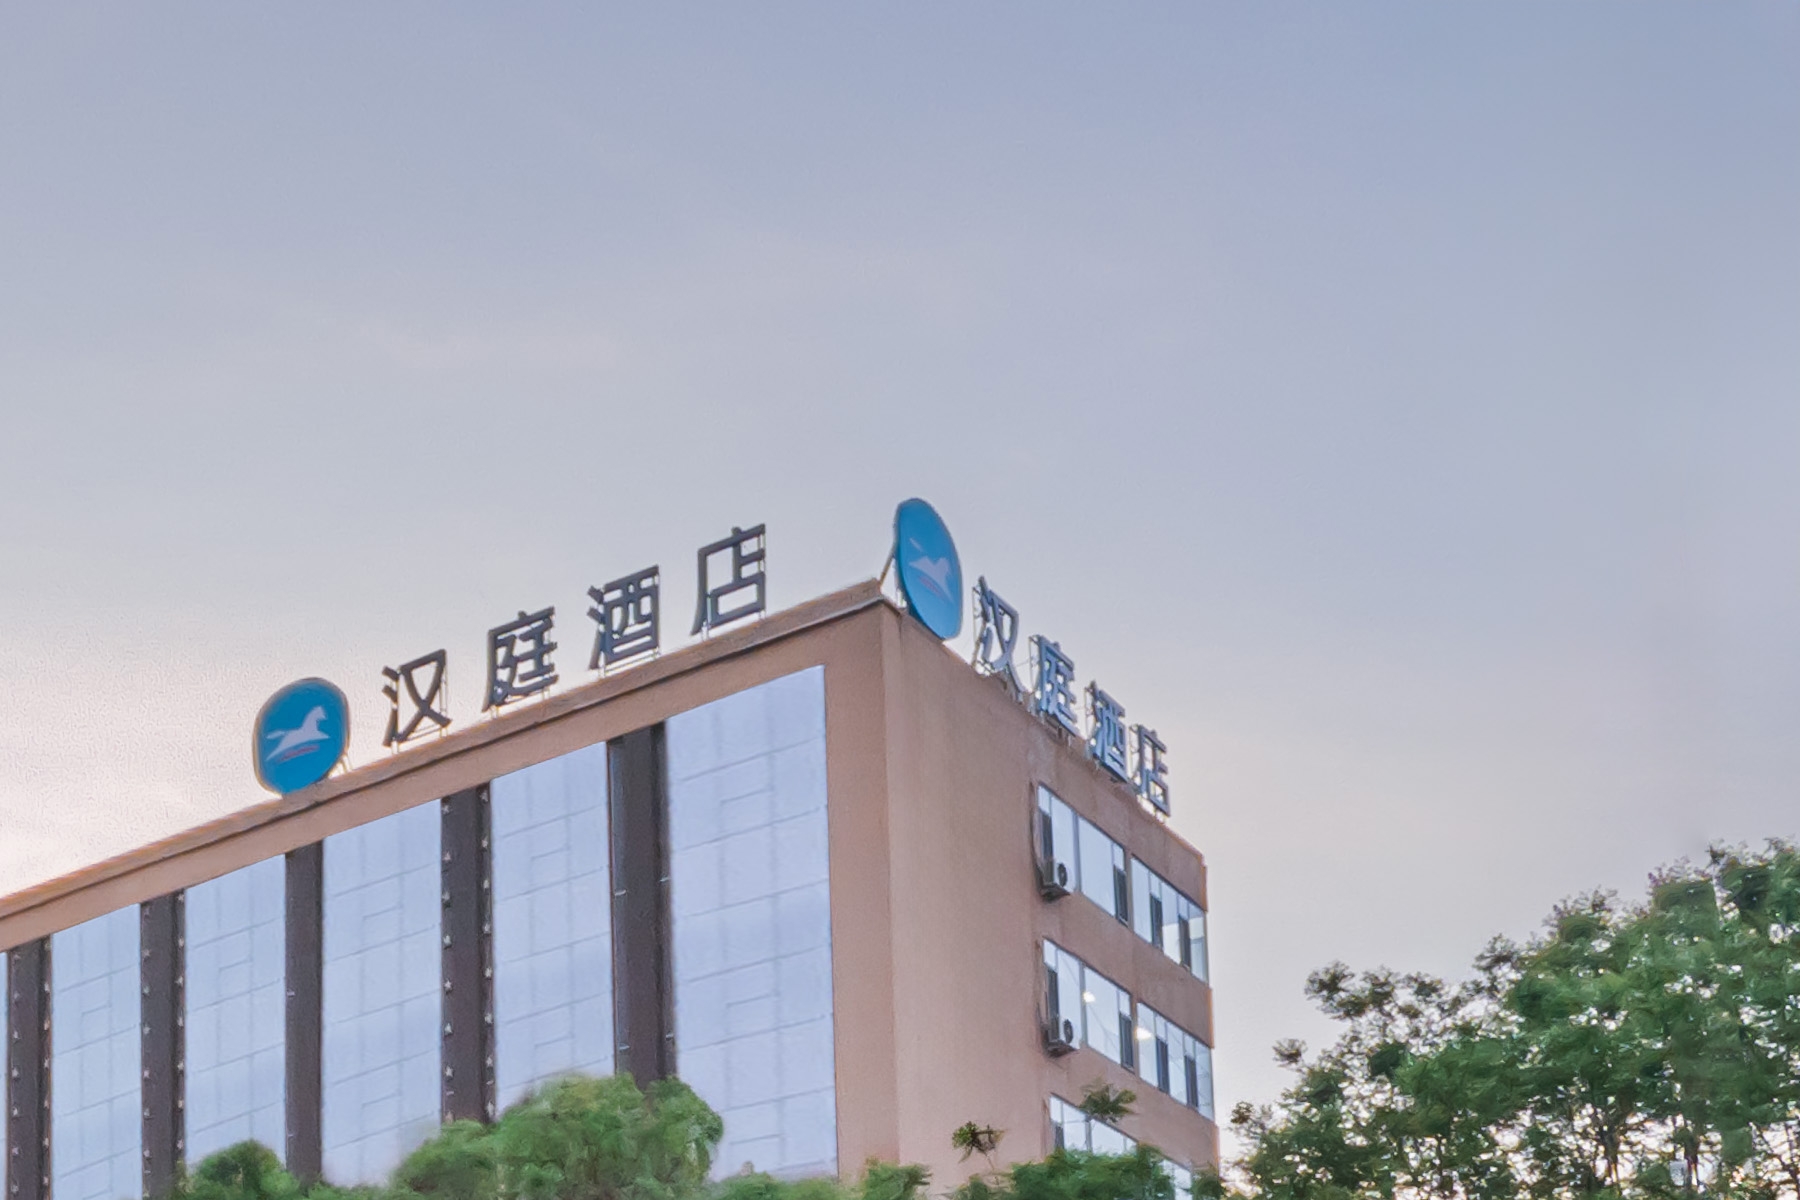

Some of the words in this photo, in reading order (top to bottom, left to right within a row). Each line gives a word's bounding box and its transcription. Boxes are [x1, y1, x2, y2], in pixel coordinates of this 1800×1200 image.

[382, 523, 766, 747] 汉庭酒店
[974, 575, 1171, 818] 汉庭酒店
